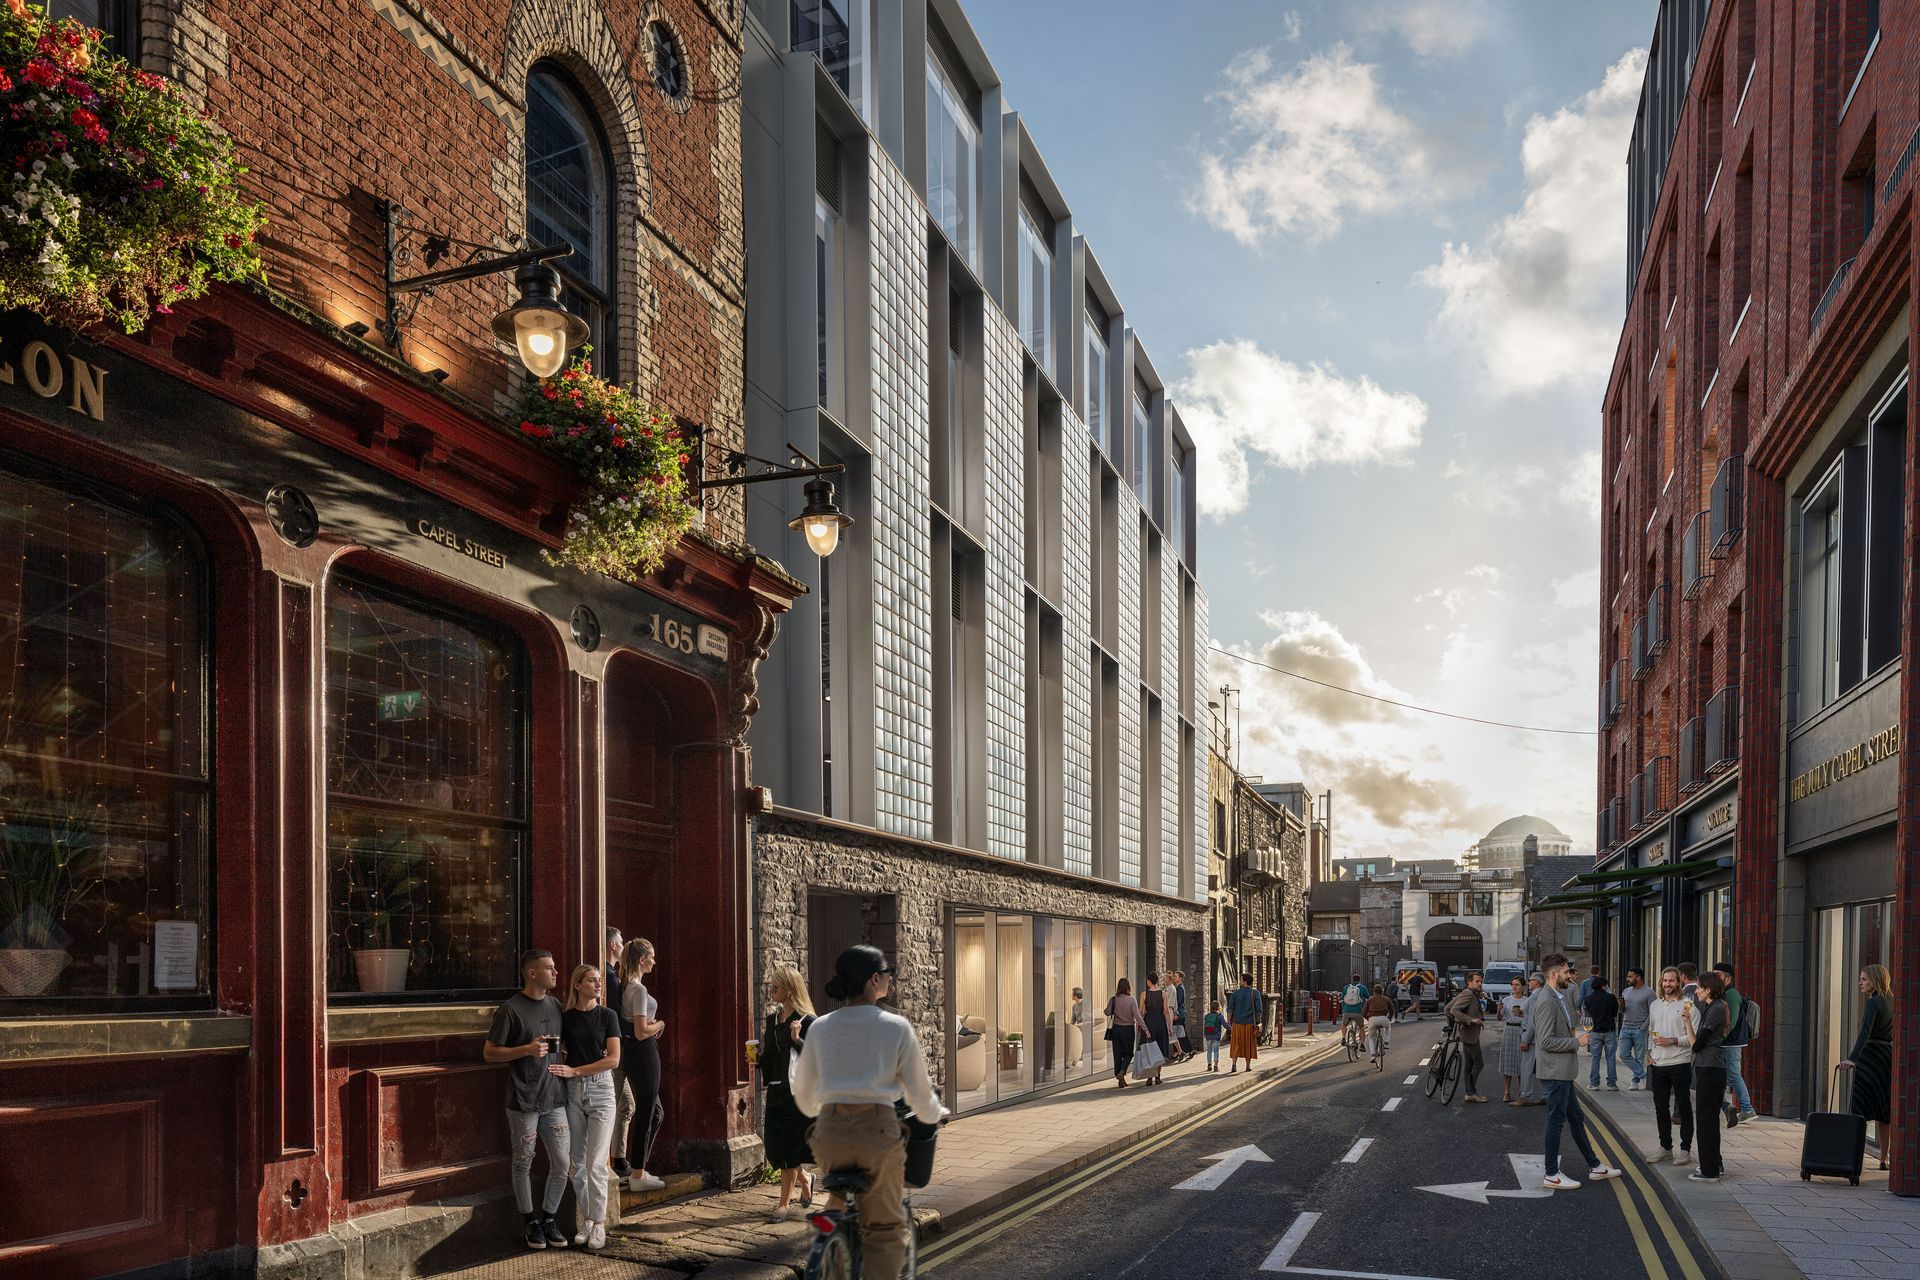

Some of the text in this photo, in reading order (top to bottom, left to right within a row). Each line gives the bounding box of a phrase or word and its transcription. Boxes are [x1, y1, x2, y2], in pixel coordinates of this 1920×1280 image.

[418, 519, 508, 569] CAPEL STREET
[649, 613, 694, 654] 165
[1791, 774, 1806, 802] THE
[1807, 760, 1830, 795] JULY
[1831, 743, 1864, 782] CAPEL
